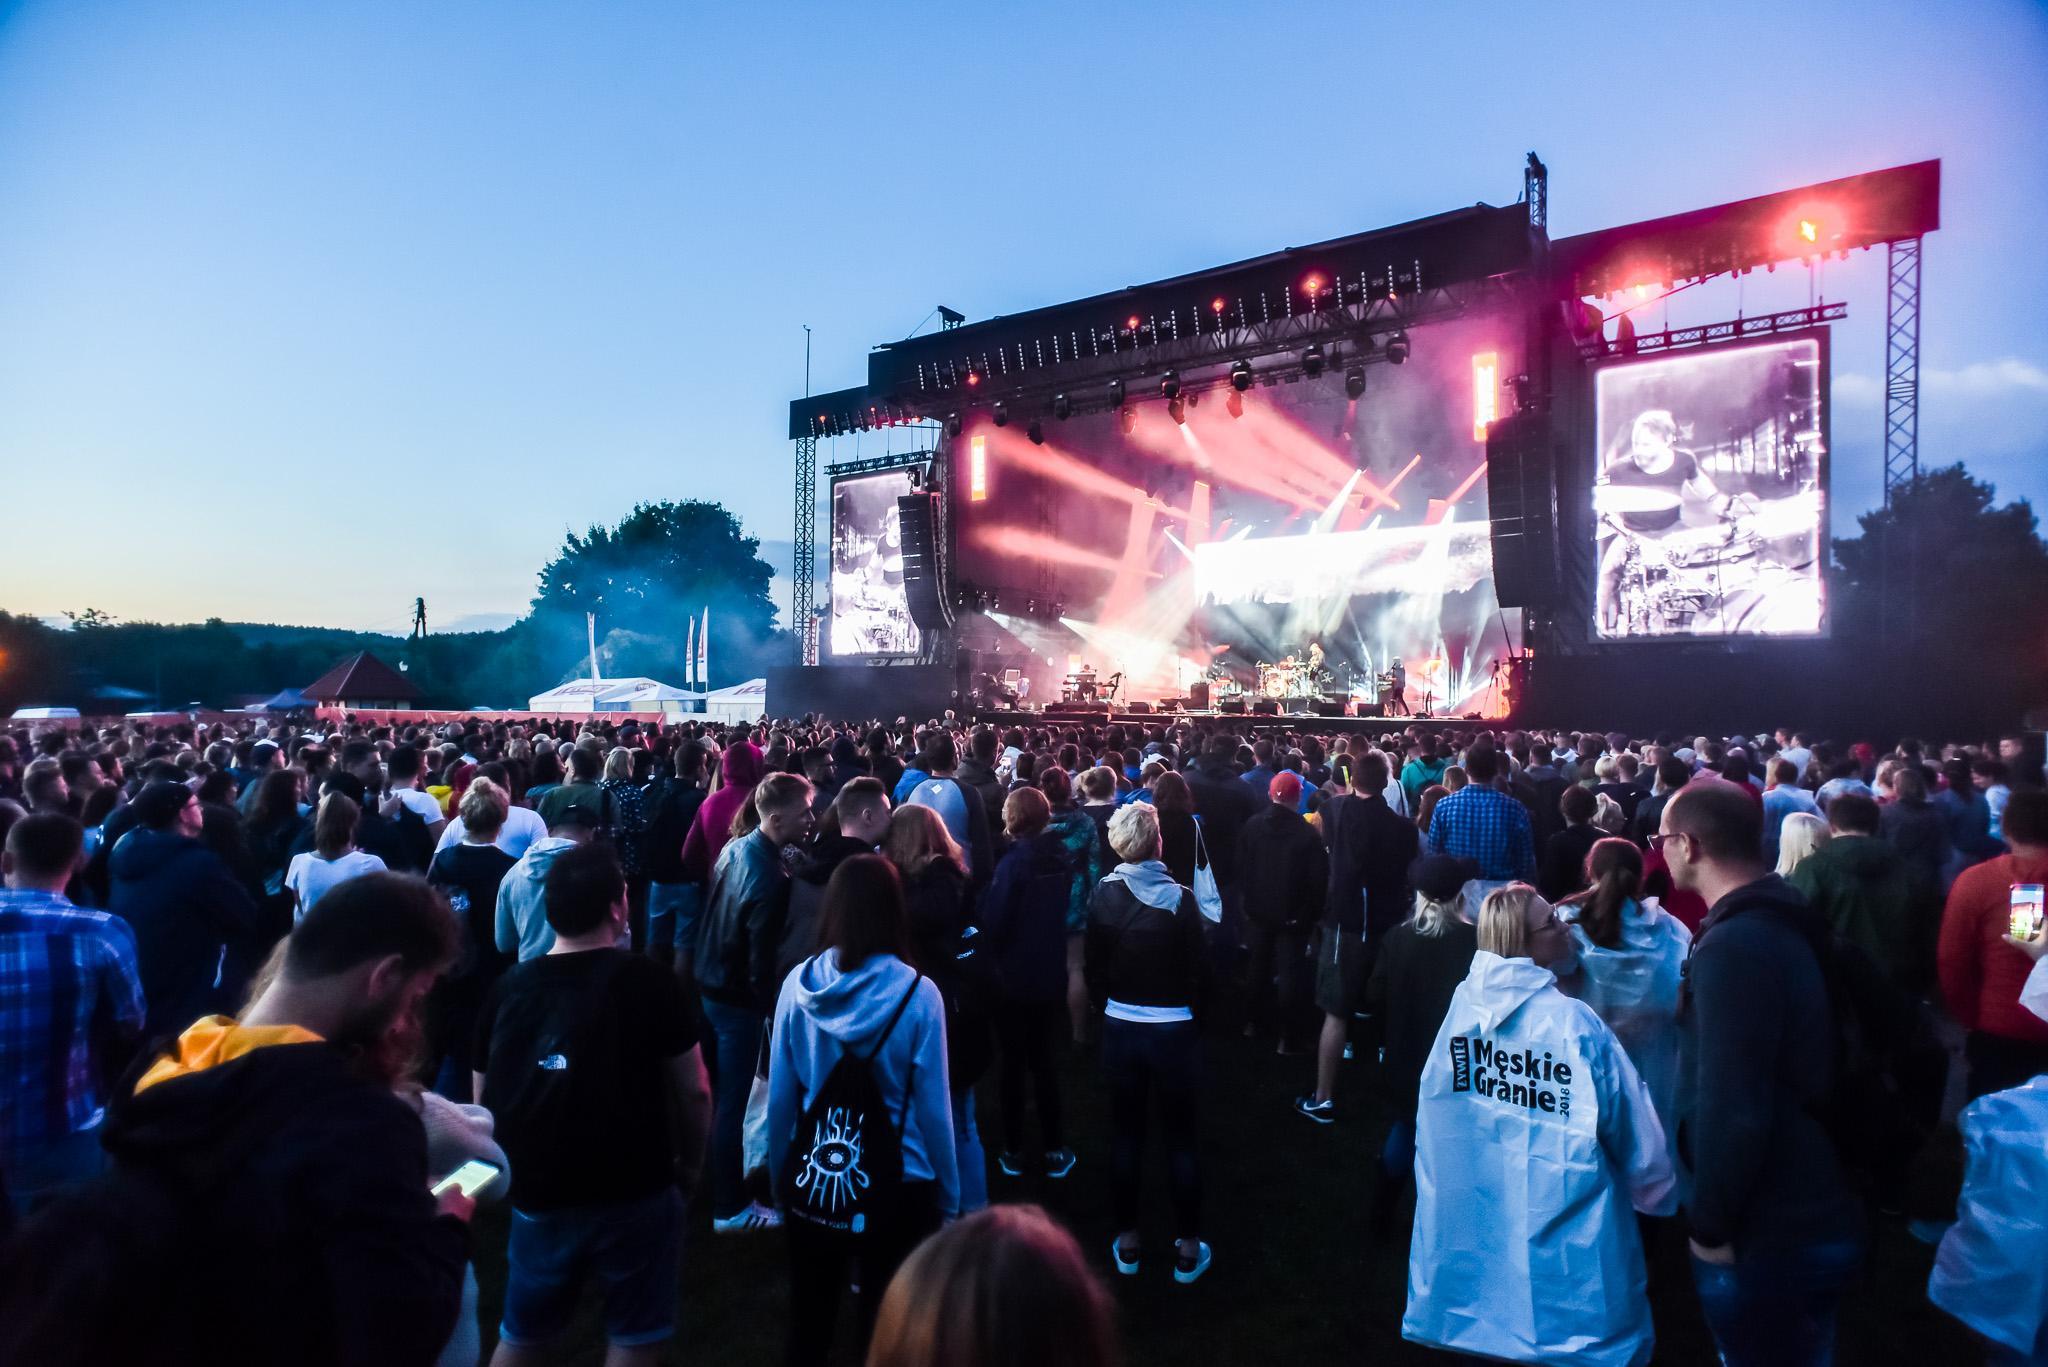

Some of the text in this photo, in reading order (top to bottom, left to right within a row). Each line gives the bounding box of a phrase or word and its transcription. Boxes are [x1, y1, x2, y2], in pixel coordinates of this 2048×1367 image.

[1473, 1039, 1572, 1085] Męskie
[1474, 1066, 1556, 1113] Granie
[1560, 1088, 1570, 1118] 2018
